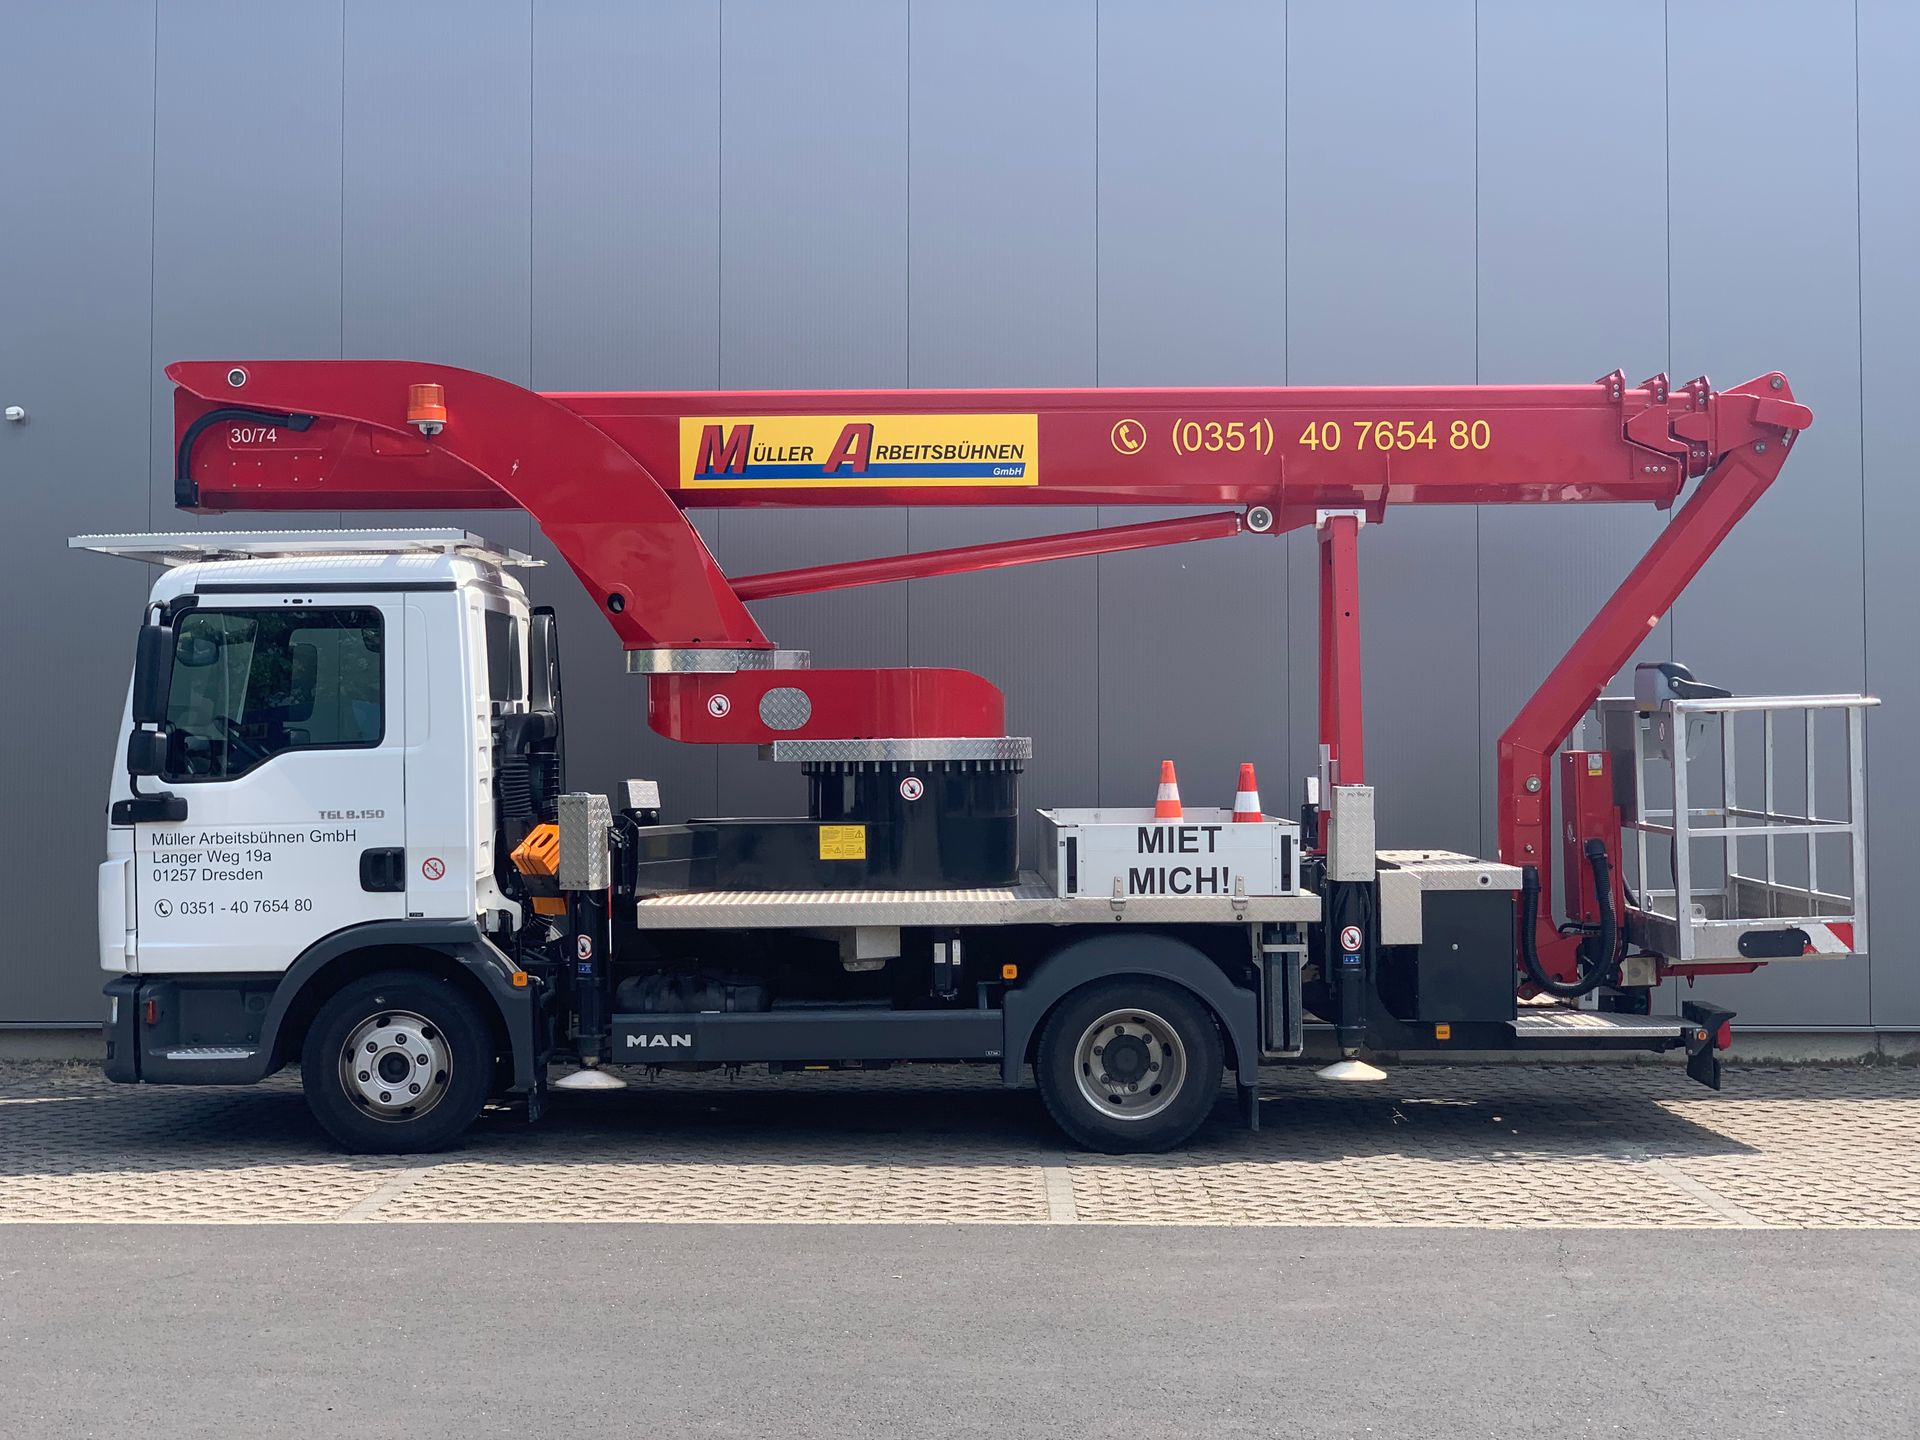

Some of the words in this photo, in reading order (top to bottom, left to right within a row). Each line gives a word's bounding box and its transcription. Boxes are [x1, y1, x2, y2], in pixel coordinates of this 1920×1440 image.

[231, 428, 277, 443] 30/74
[1172, 418, 1274, 455] (0351)
[1299, 421, 1341, 451] 40
[1353, 420, 1437, 451] 7654
[1449, 420, 1491, 450] 80
[694, 424, 813, 474] MÜLLER
[822, 422, 1025, 474] ARBEITSBÜHNEN
[992, 466, 1023, 476] GmbH
[319, 811, 345, 820] TGL
[346, 810, 385, 819] 8.150
[151, 832, 196, 846] Müller
[199, 830, 305, 844] Arbeitsbühnen
[309, 829, 356, 843] GmbH
[1137, 826, 1222, 853] MIET
[152, 851, 202, 866] Langer
[207, 850, 240, 865] Weg
[245, 849, 272, 862] 19a
[152, 868, 197, 882] 01257
[202, 867, 263, 881] Dresden
[1129, 866, 1229, 894] MICH!
[180, 901, 215, 915] 0351
[230, 900, 248, 914] 40
[253, 899, 290, 913] 7654
[294, 898, 312, 912] 80
[626, 1034, 692, 1047] MAN
